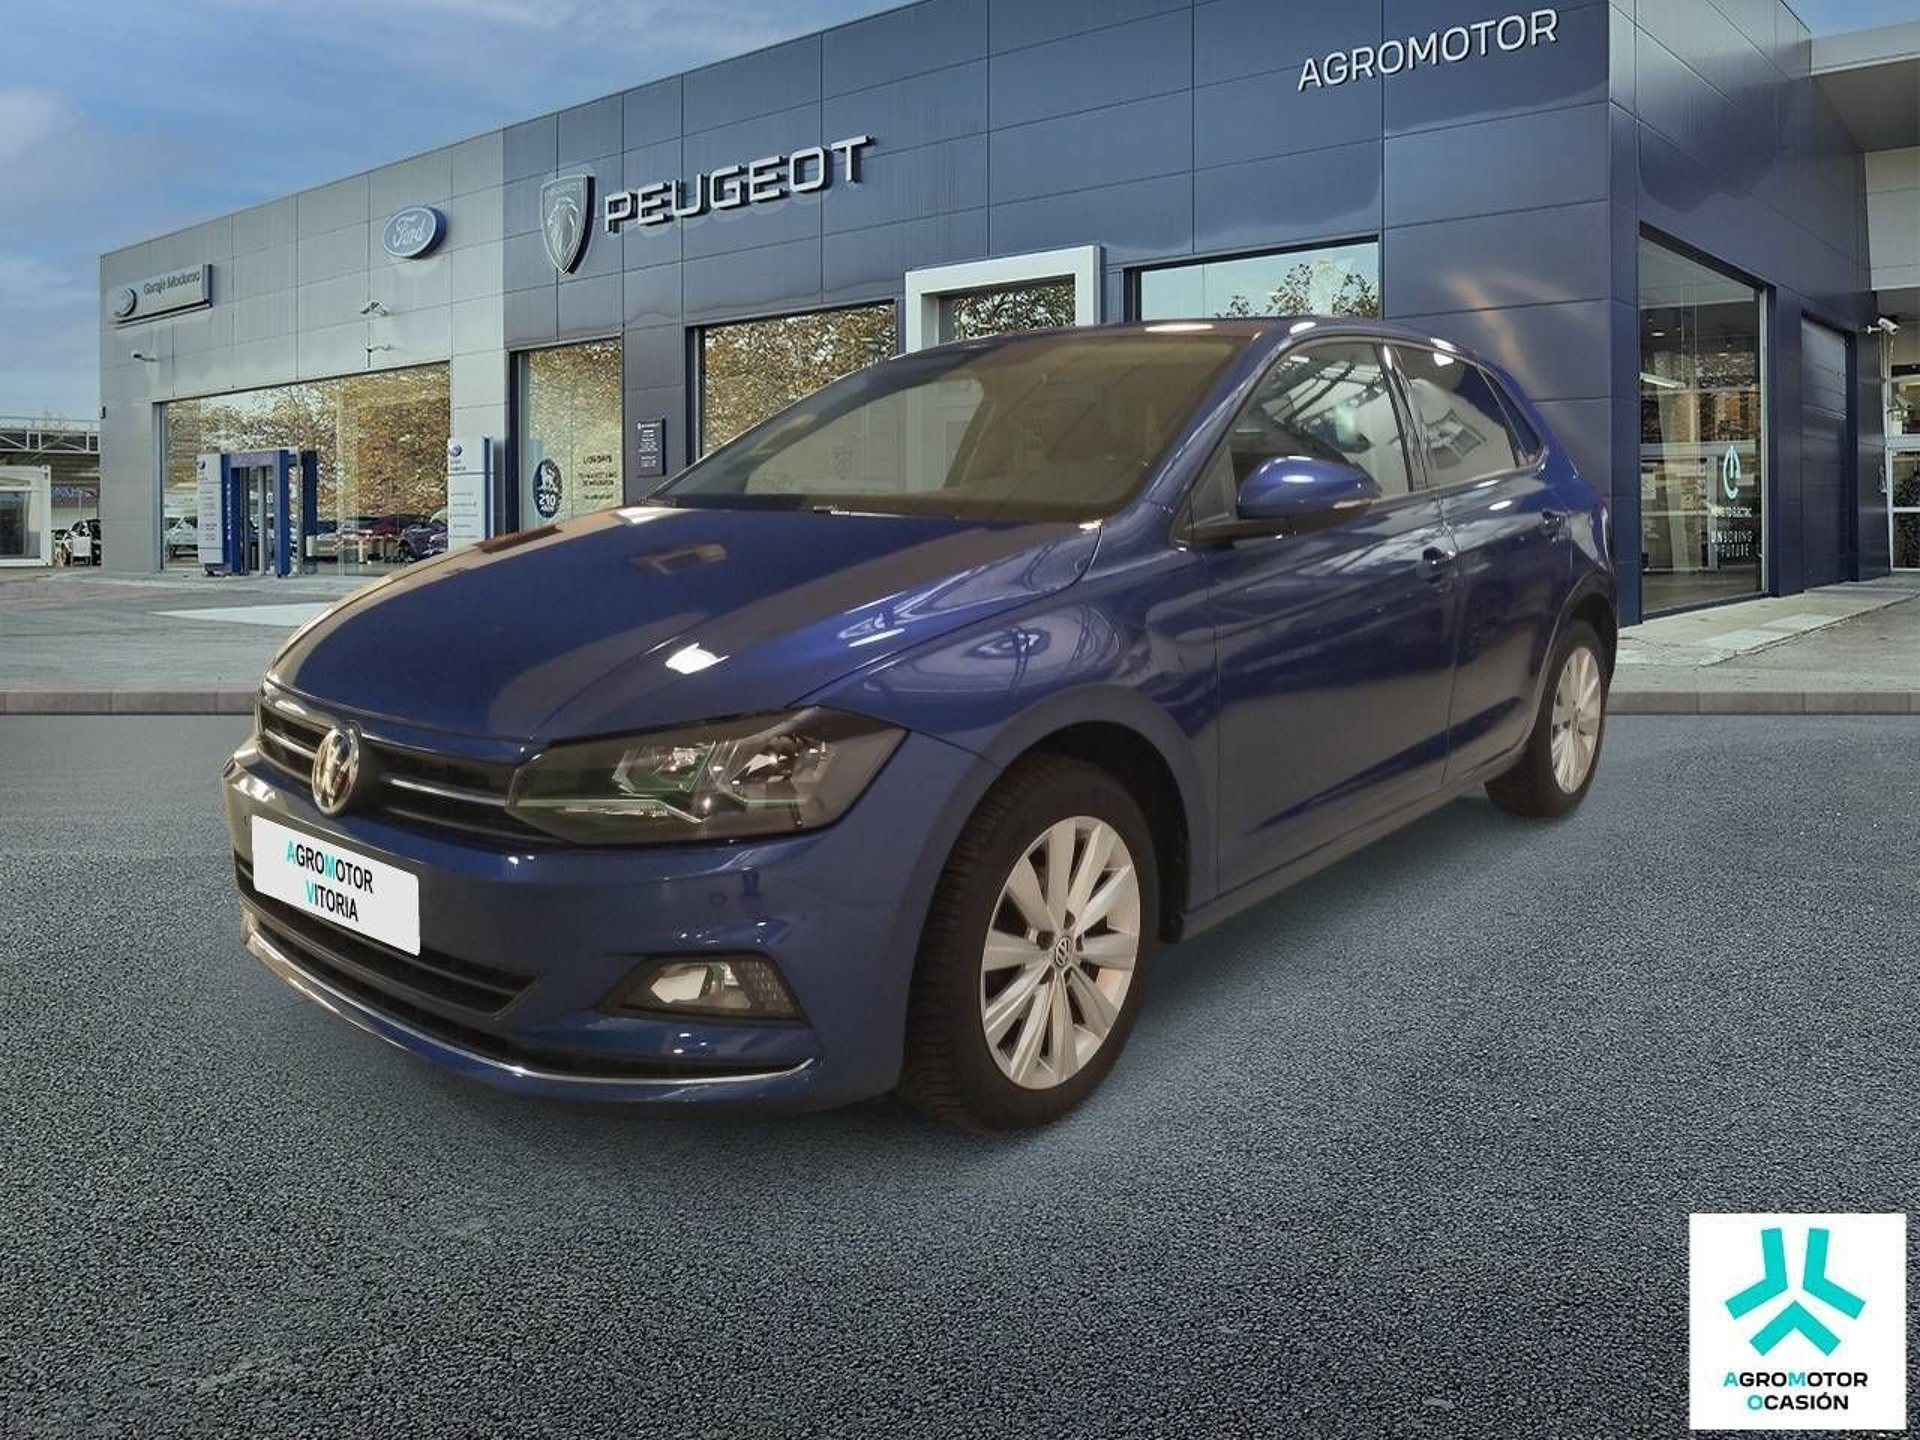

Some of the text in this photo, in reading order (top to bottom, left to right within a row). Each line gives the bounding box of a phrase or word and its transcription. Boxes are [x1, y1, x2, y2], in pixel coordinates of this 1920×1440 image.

[1297, 8, 1559, 91] AGROMOTOR
[604, 135, 870, 233] PEUGEOT
[393, 214, 427, 248] Ford
[539, 494, 556, 506] 210
[287, 840, 374, 894] AGROMOTOR
[306, 878, 359, 922] VITORIA
